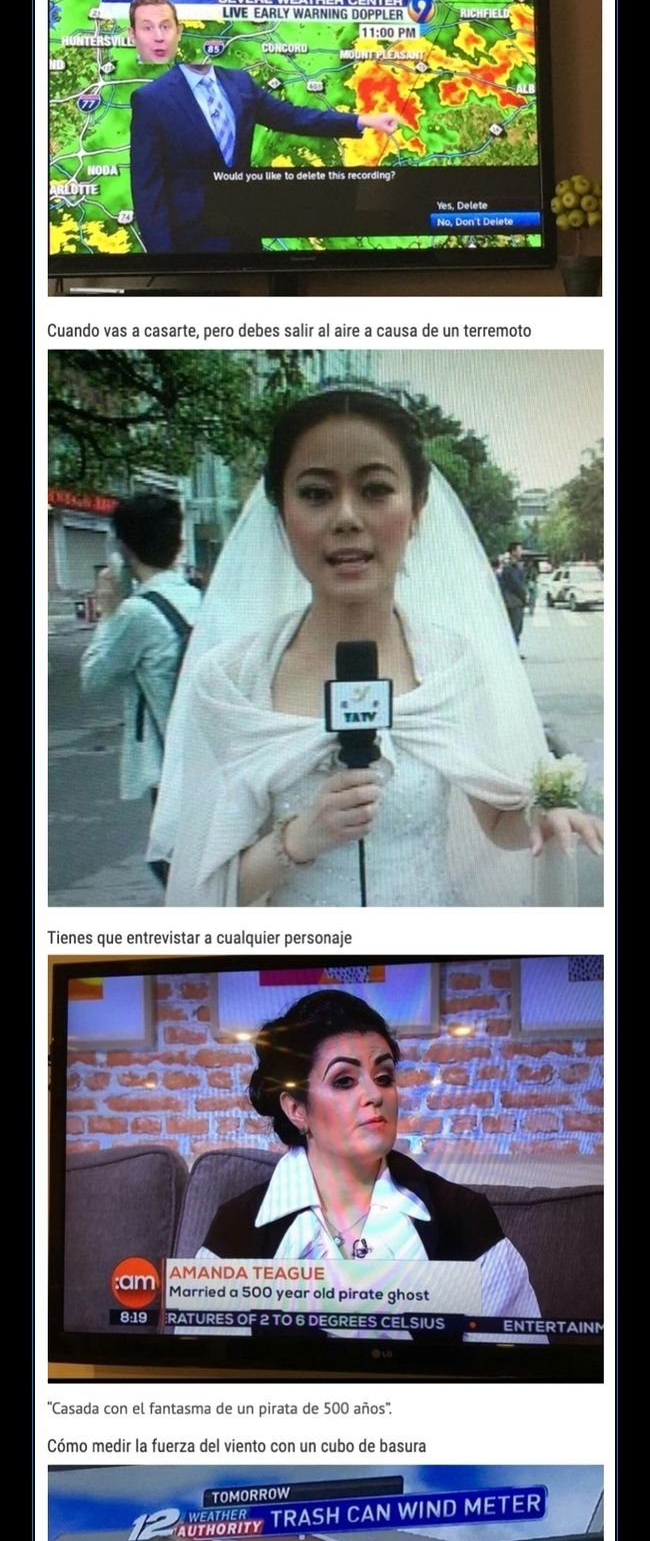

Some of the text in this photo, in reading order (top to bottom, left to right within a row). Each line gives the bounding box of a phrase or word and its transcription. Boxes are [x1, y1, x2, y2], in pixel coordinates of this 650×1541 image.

[223, 7, 404, 20] LIVE EARLY WARNING DOPPLER
[362, 27, 416, 38] 11:00 PM
[262, 43, 308, 53] CONCORD
[437, 200, 488, 212] Yes, Delete
[437, 216, 513, 227] No, Don't Delete
[170, 1266, 325, 1280] AMANDA TEAGUE
[170, 1286, 430, 1304] Married a 500 year old pirate ghost
[120, 1311, 148, 1323] 8:19
[212, 1487, 291, 1503] TOMORROW
[271, 1494, 541, 1528] TRASH CAN WIND METER
[127, 1508, 181, 1541] 12
